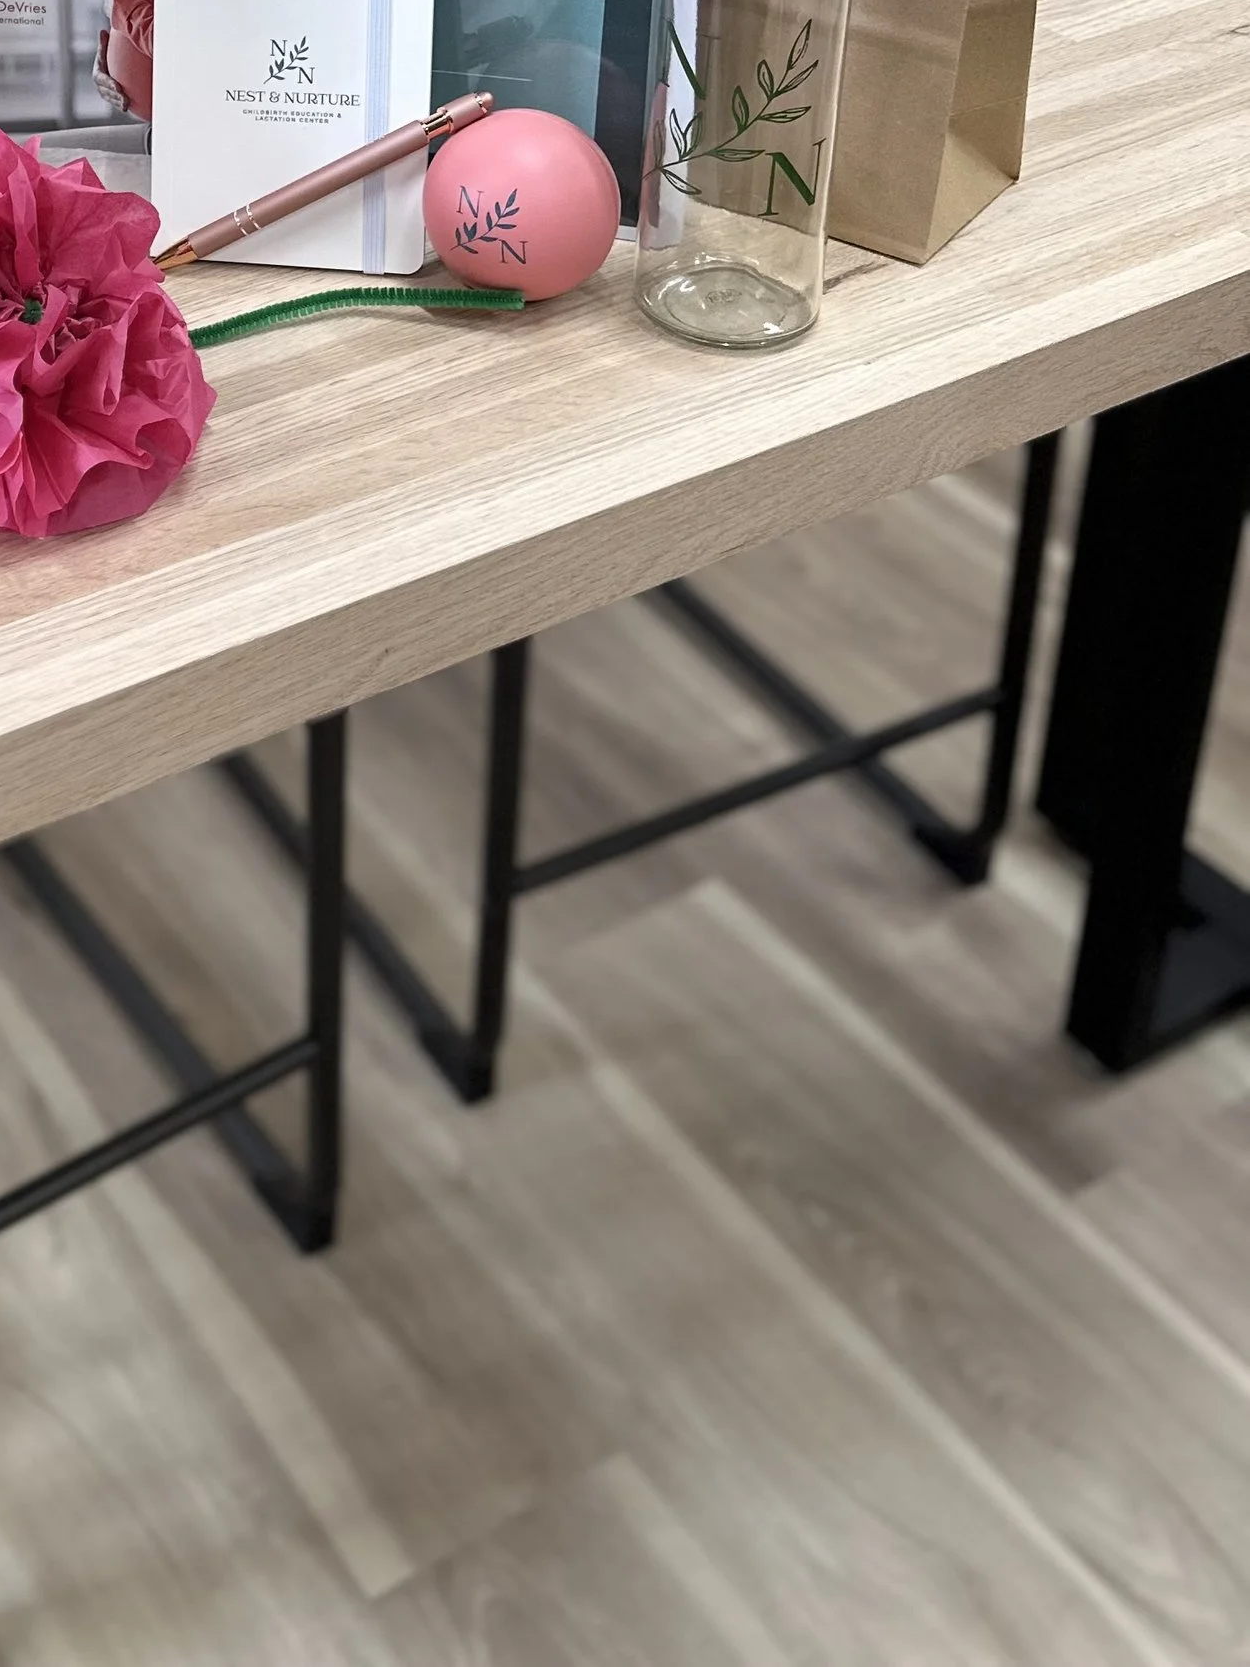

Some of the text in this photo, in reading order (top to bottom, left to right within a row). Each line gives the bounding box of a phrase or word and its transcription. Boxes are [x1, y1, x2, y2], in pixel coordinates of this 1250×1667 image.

[270, 39, 288, 57] N
[297, 66, 316, 84] N
[225, 89, 361, 106] NEST & NURTURE
[758, 138, 826, 216] N
[456, 185, 484, 219] N
[498, 240, 529, 265] N
